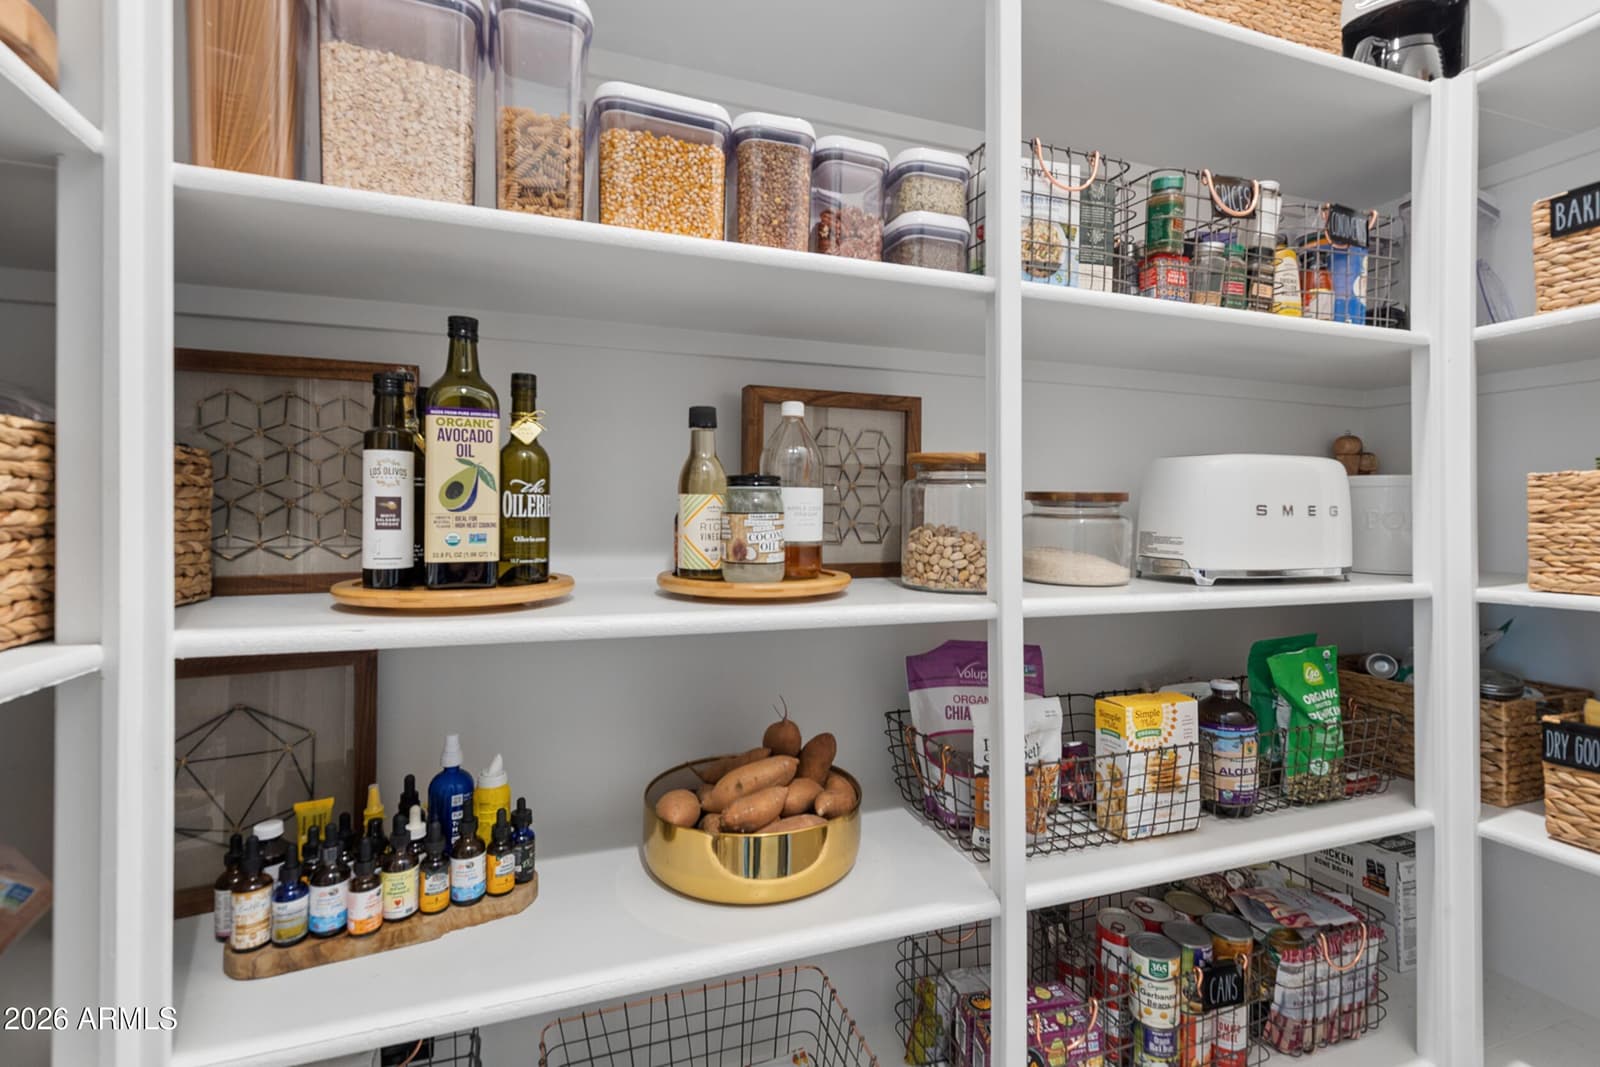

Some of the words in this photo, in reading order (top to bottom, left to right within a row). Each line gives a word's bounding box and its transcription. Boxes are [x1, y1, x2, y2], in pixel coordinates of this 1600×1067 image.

[1555, 191, 1600, 231] BAKI
[436, 416, 494, 429] ORGANIC
[437, 427, 493, 443] AVOCADO
[456, 443, 475, 458] OIL
[369, 467, 381, 477] LOS
[1256, 505, 1339, 517] SMEG
[945, 705, 972, 720] CHIA
[1135, 708, 1160, 719] Simple
[1546, 729, 1569, 760] DRY
[1575, 735, 1600, 767] GOO
[1151, 963, 1167, 972] 365
[1210, 974, 1238, 1004] CANS
